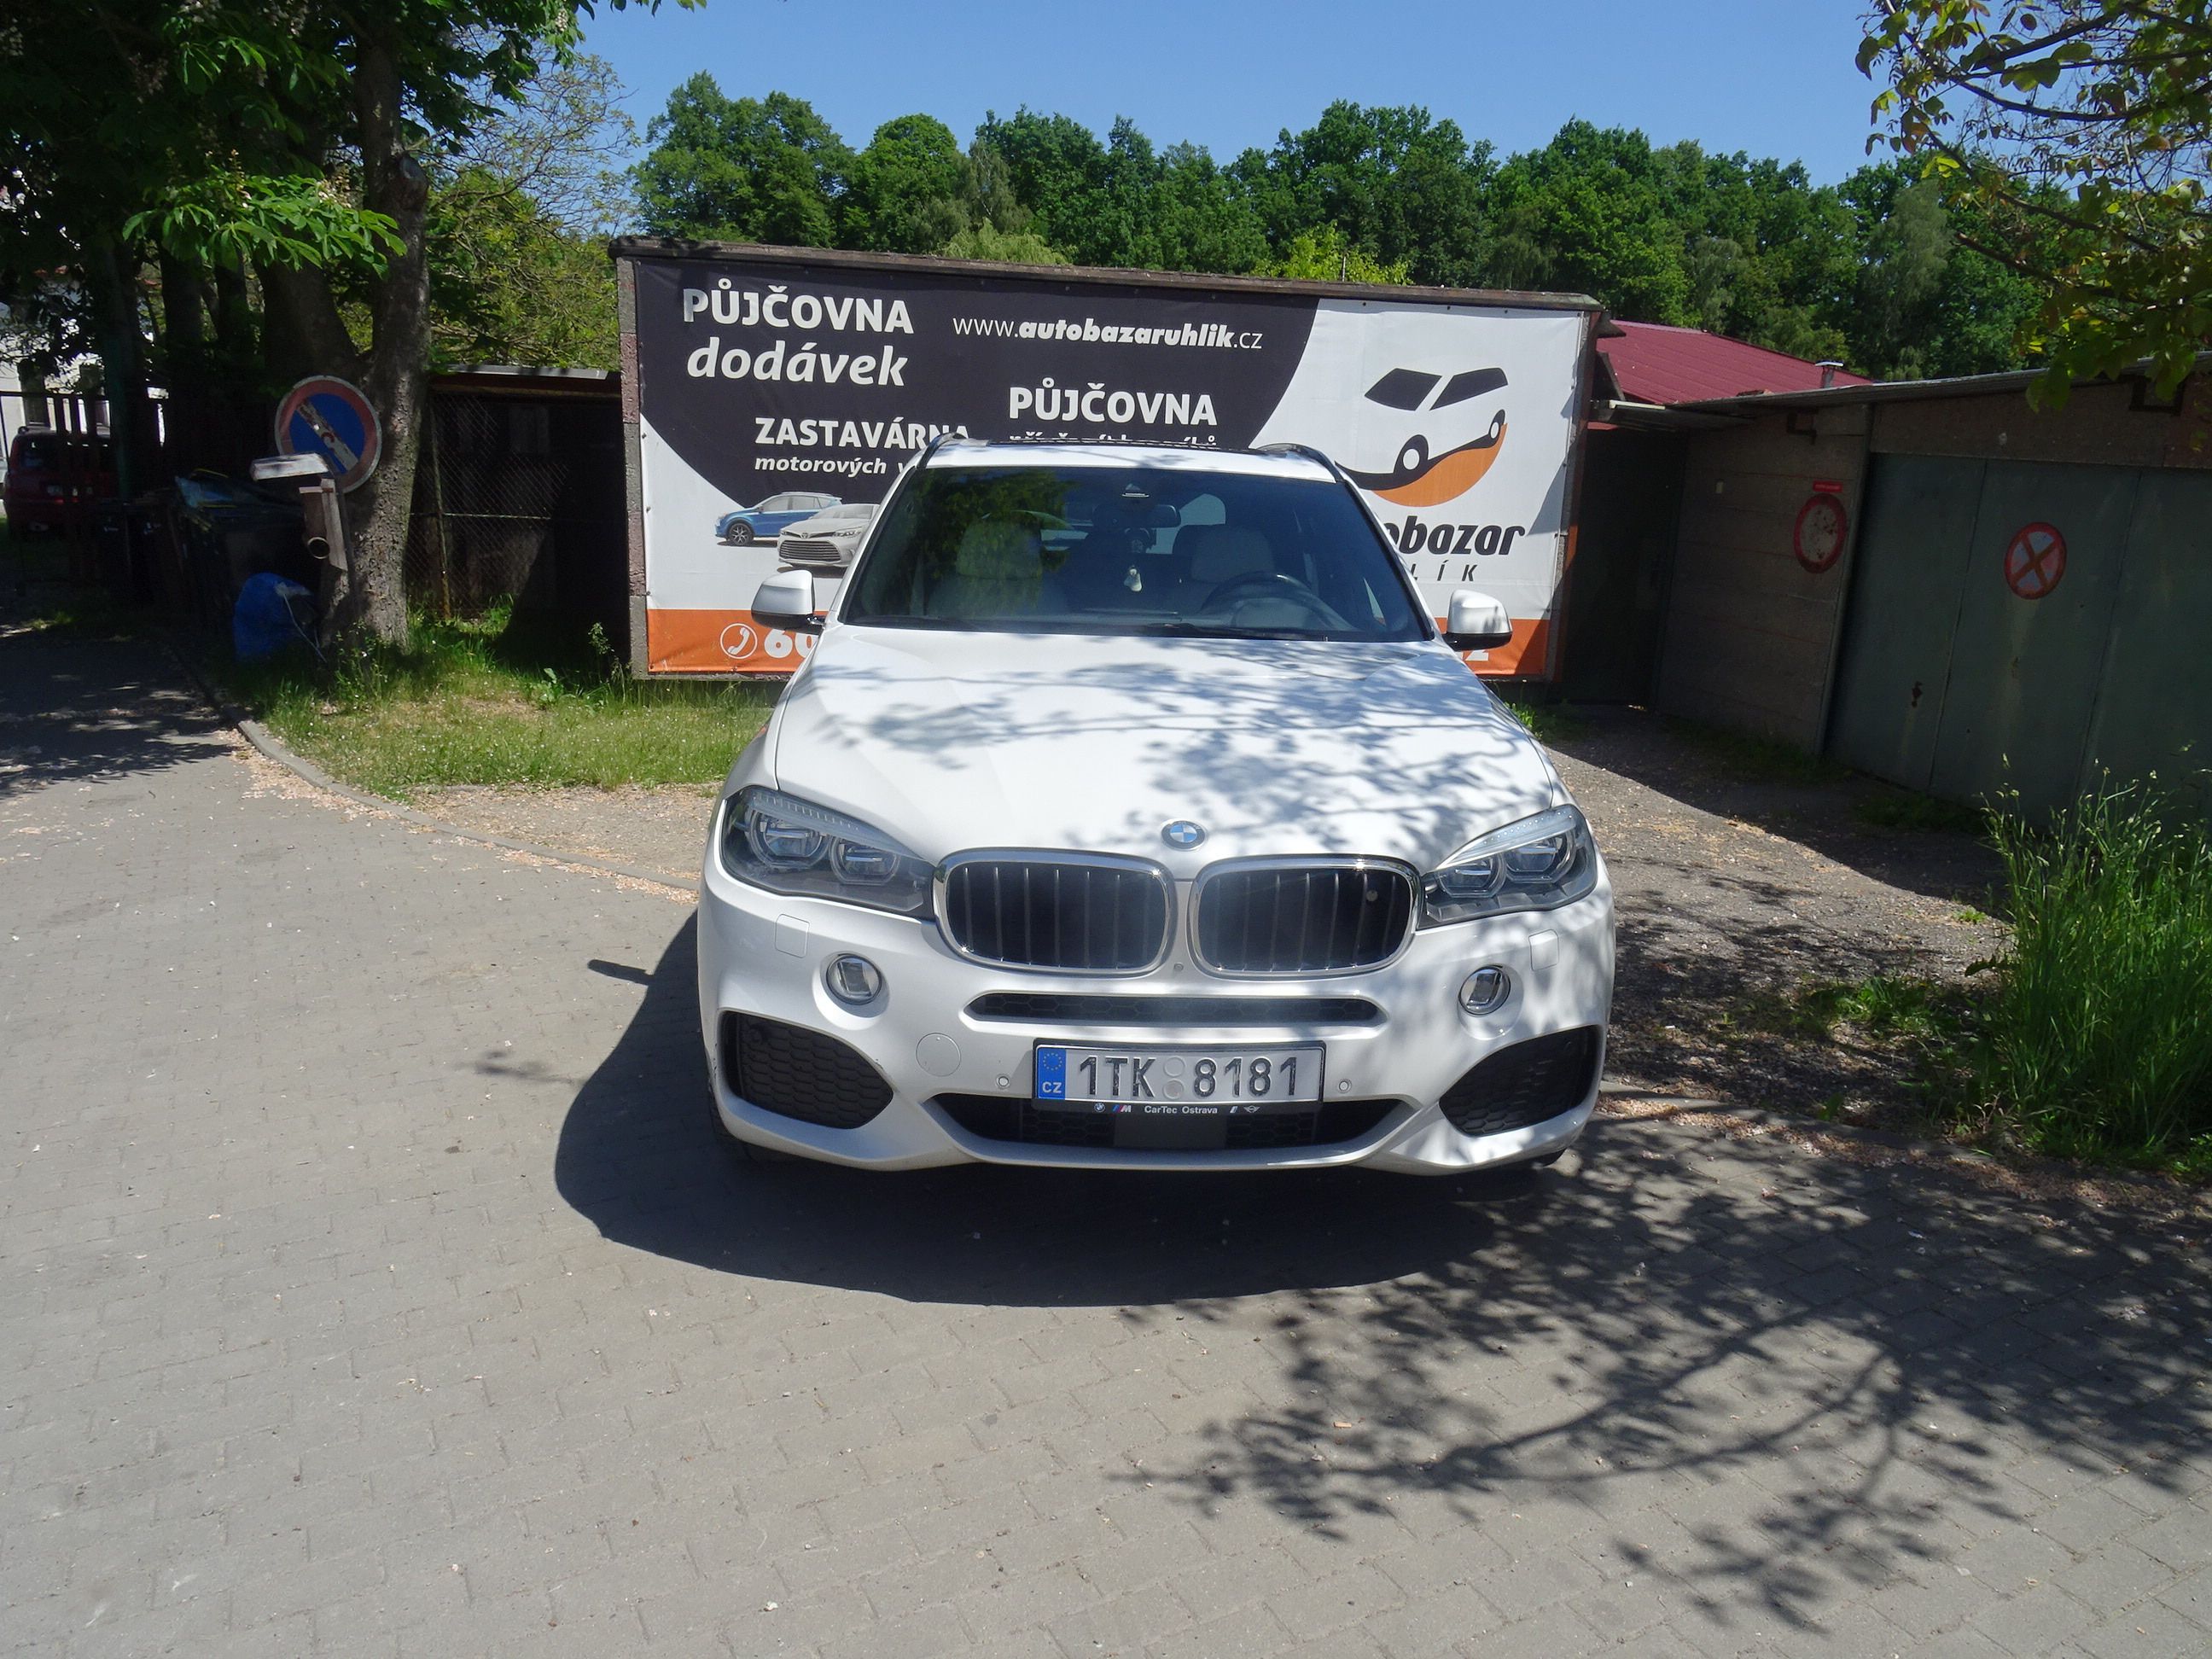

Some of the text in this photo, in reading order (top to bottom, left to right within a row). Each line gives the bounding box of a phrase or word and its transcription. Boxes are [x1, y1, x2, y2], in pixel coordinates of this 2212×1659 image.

[683, 277, 914, 335] PŮJČOVNA
[952, 317, 1263, 350] www.autobazaruhlik.cz
[686, 336, 909, 387] dodávek
[1009, 377, 1218, 426] PŮJČOVNA
[754, 457, 887, 479] motorových
[1042, 1081, 1062, 1094] CZ
[1080, 1057, 1298, 1097] 1TK 8181
[1144, 1105, 1178, 1114] CarTec
[1182, 1106, 1218, 1115] Ostrava
